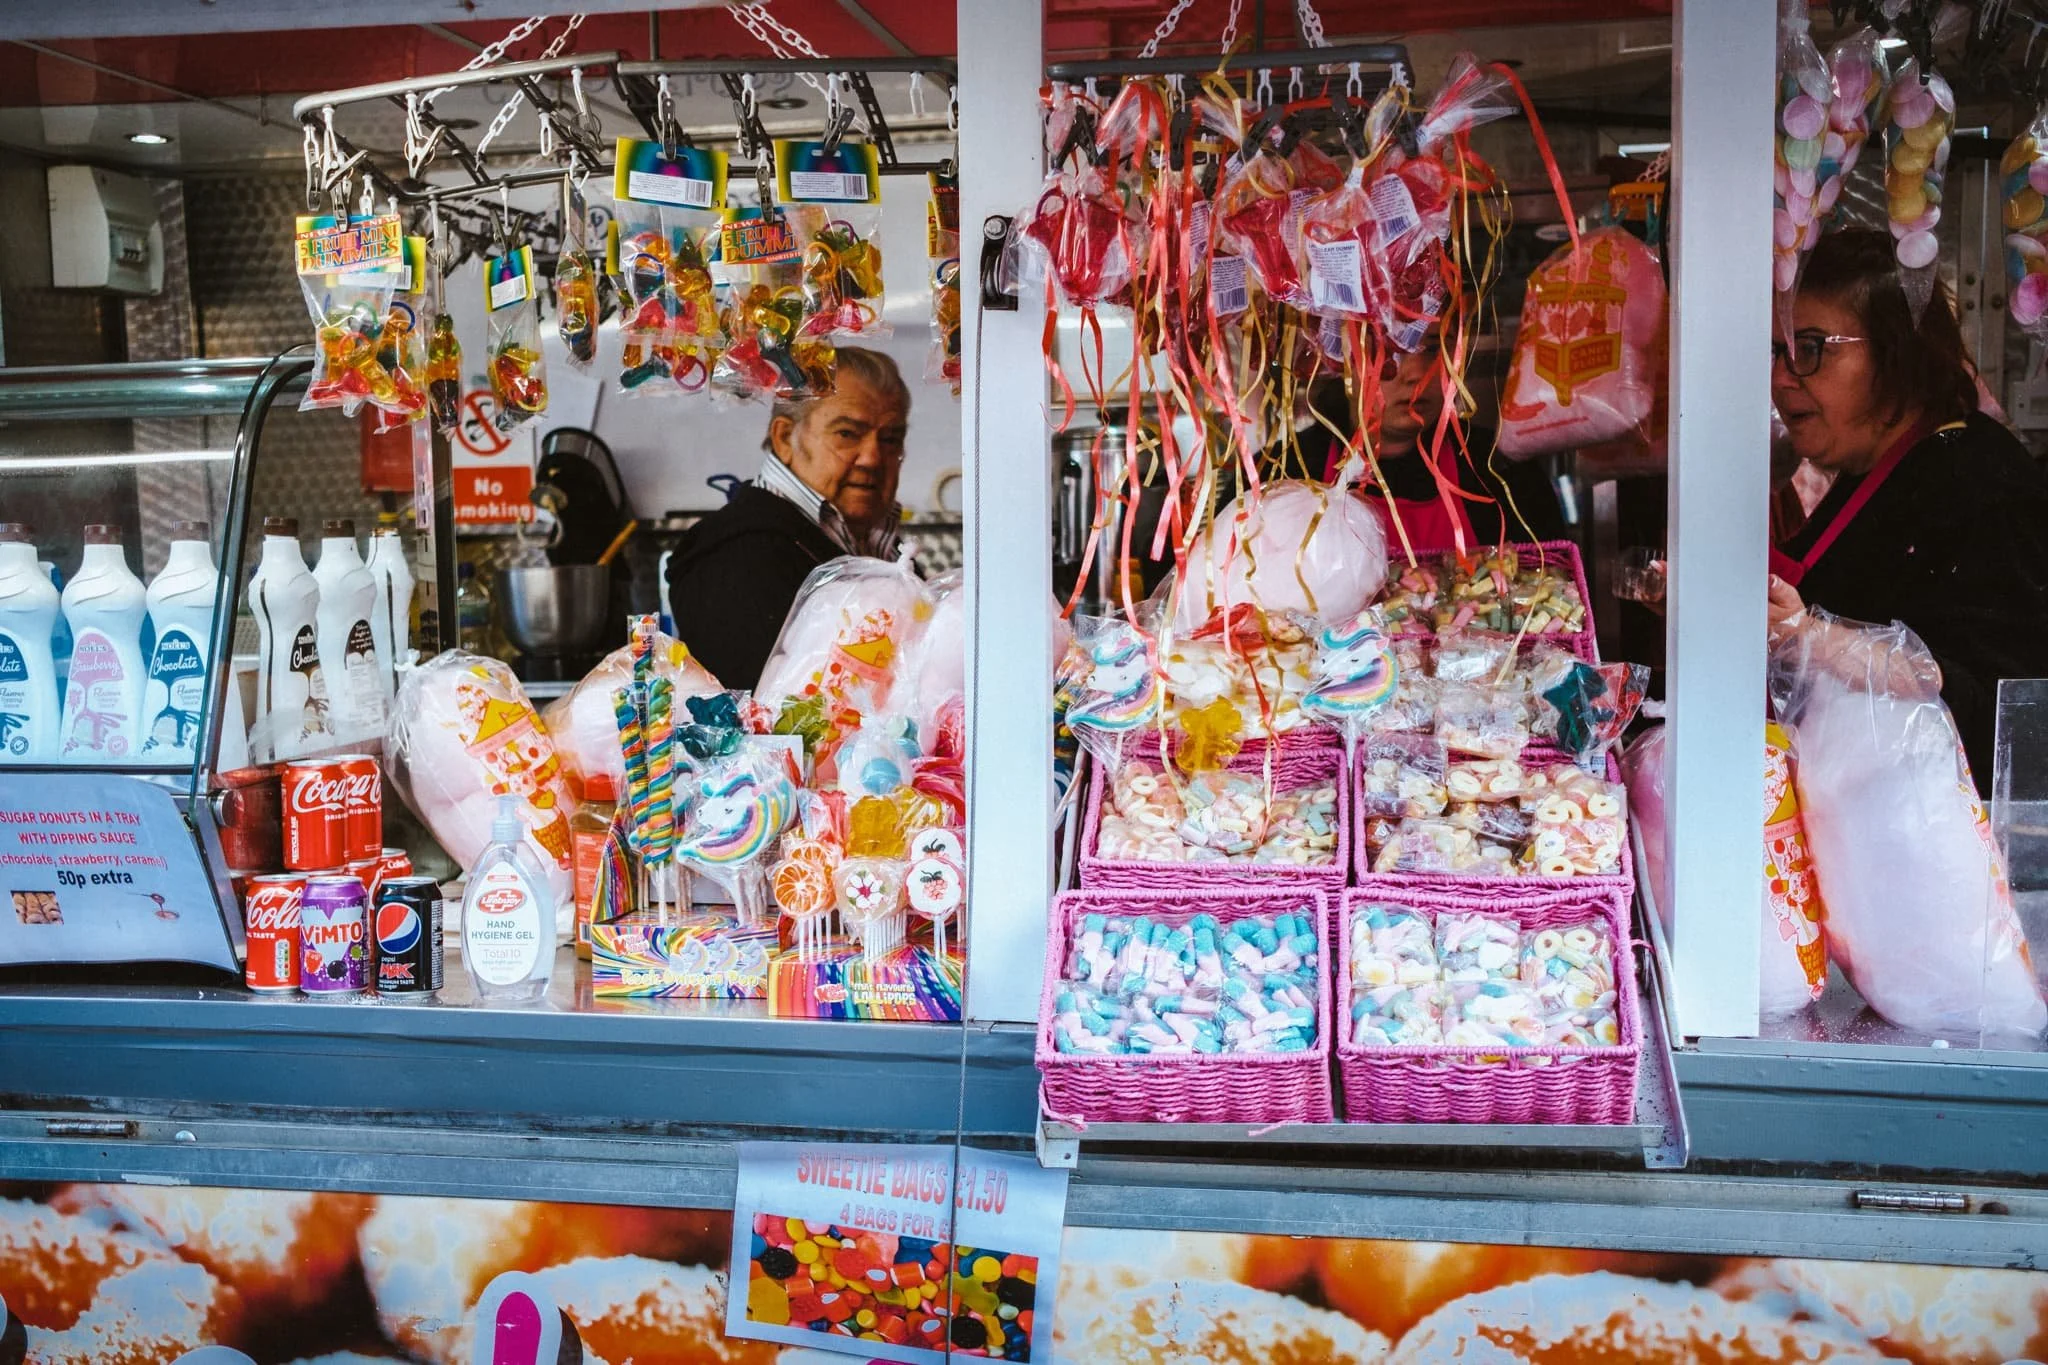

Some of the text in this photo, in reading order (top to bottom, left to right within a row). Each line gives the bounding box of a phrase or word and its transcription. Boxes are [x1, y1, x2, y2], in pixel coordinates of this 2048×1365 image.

[300, 242, 308, 257] 5
[360, 223, 398, 244] MINI
[724, 233, 733, 246] 5
[301, 240, 399, 271] DUMMIES
[475, 477, 503, 497] No
[153, 653, 199, 675] Chocolate
[0, 811, 142, 826] SUGAR DONUTS IN A TRAY
[18, 832, 137, 845] WITH DIPPING SAUCE
[59, 854, 123, 867] strawberry,
[57, 869, 134, 889] 50p extra
[486, 920, 516, 928] HAND
[471, 931, 535, 939] HYGIENE GEL
[484, 949, 509, 958] Total
[797, 1151, 888, 1196] SWEETIE
[891, 1160, 948, 1205] BAGS
[840, 1203, 850, 1224] 4
[854, 1205, 898, 1231] BAGS
[901, 1212, 935, 1238] FOR
